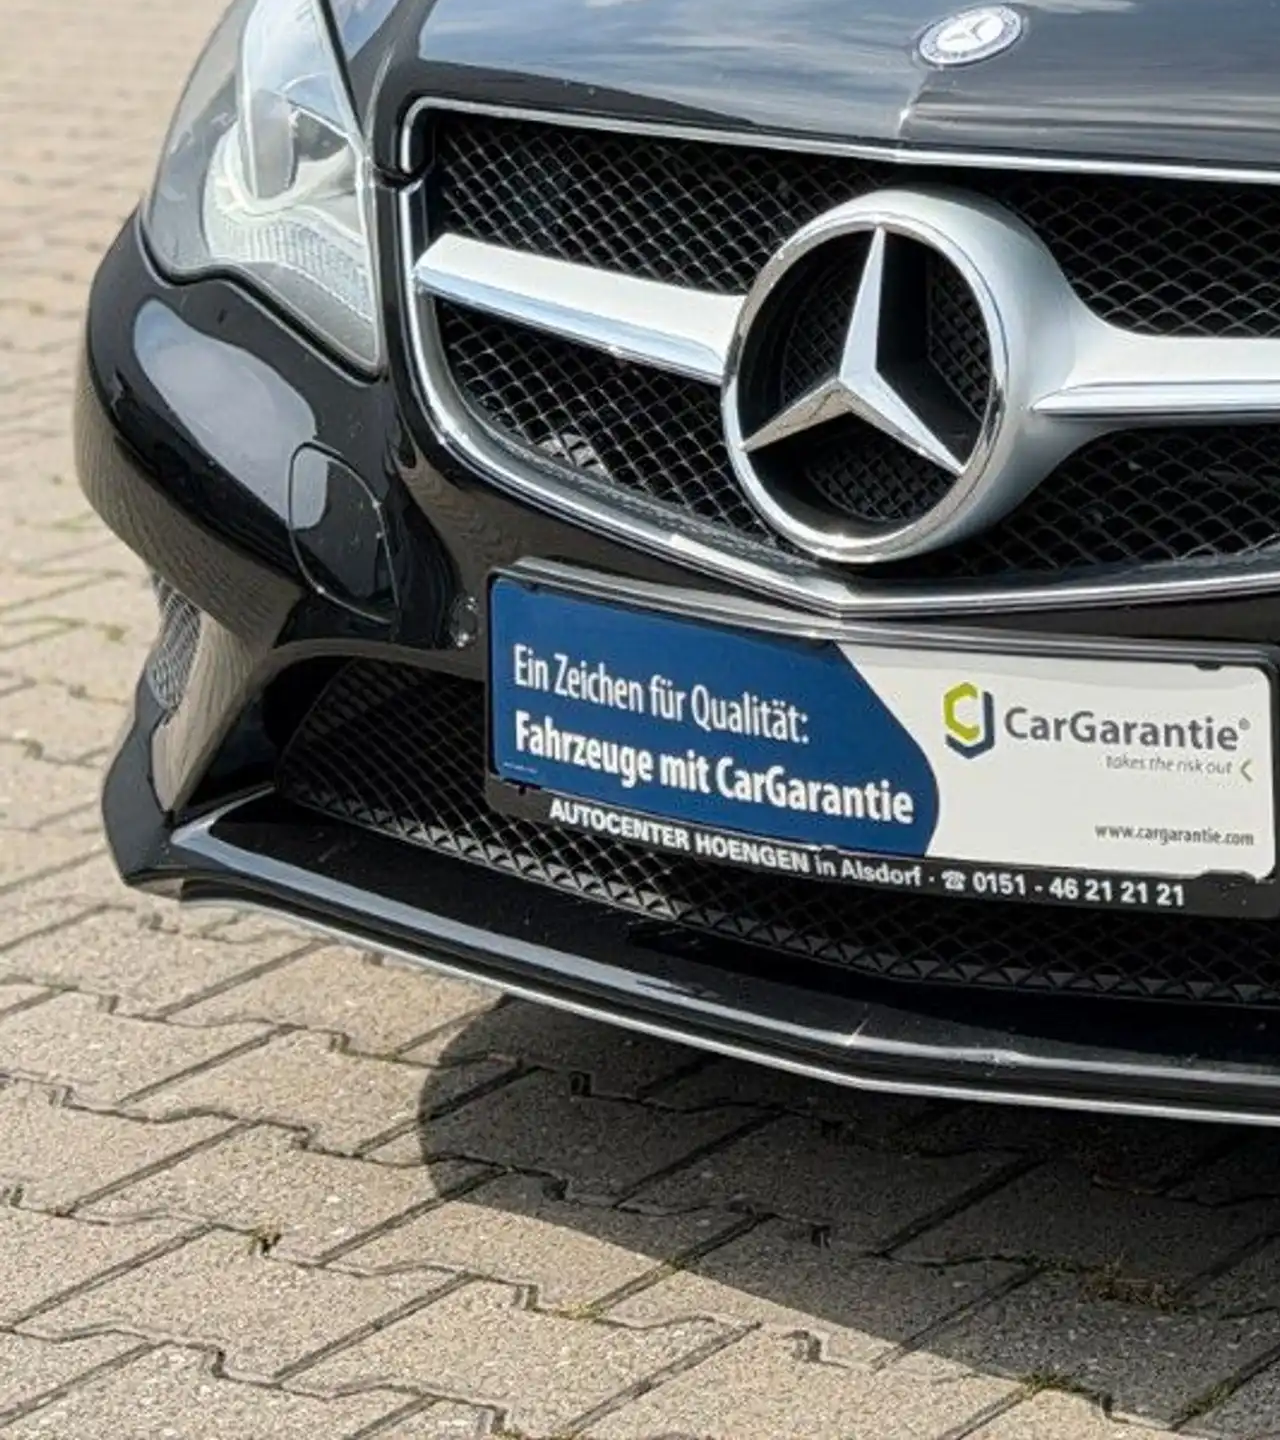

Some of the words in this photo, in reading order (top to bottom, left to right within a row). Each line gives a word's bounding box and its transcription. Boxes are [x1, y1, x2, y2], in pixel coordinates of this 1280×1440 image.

[513, 643, 549, 693] Ein
[554, 652, 644, 714] Zeichen
[648, 674, 688, 722] für
[690, 684, 810, 744] Qualität:
[515, 709, 654, 789] Fahrzeuge
[659, 749, 711, 794] mit
[715, 755, 915, 825] CarGarantie
[1106, 755, 1145, 771] takes
[1150, 757, 1174, 773] the
[1176, 758, 1202, 773] risk
[1205, 760, 1233, 776] out
[550, 798, 690, 852] AUTOCENTER
[695, 832, 810, 874] HOENGEN
[815, 854, 836, 877] in
[841, 863, 922, 888] Alsdorf
[972, 873, 1027, 896] 0151
[1049, 877, 1079, 901] 46
[1085, 880, 1112, 903] 21
[1120, 882, 1148, 905] 21
[1156, 884, 1185, 907] 21
[1095, 824, 1255, 847] www.cargarantie.com
